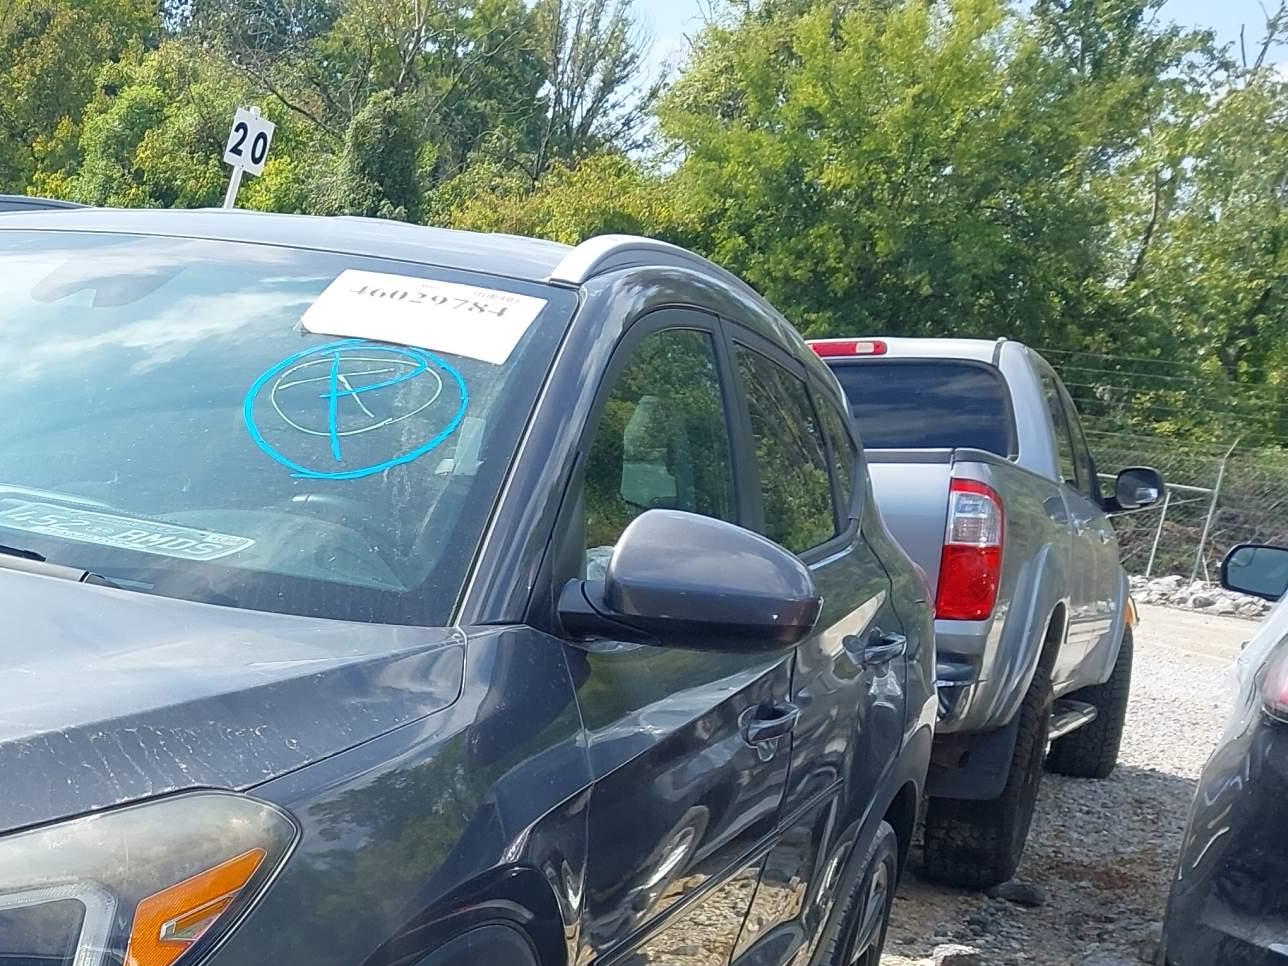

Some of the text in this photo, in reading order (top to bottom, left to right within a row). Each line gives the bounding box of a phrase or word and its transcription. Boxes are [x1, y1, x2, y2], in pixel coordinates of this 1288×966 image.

[229, 121, 268, 165] 20
[349, 285, 508, 317] 46029784
[7, 511, 90, 529] 452
[111, 528, 223, 555] BMDS
